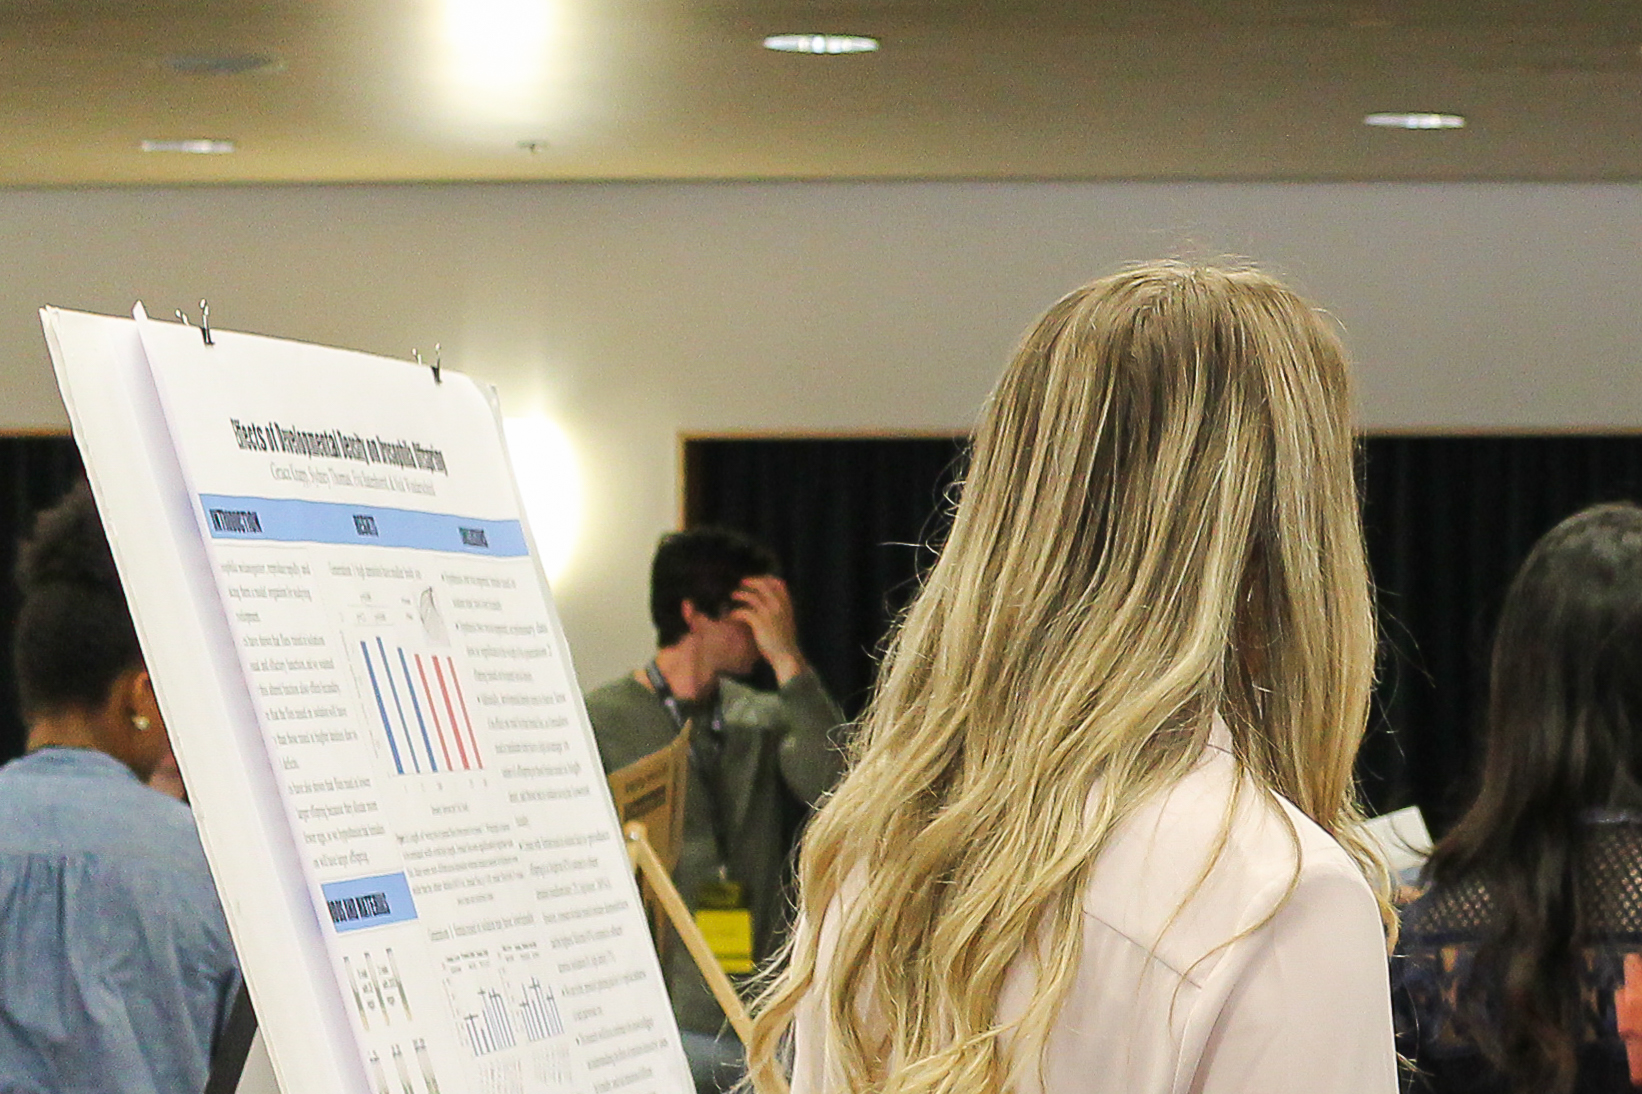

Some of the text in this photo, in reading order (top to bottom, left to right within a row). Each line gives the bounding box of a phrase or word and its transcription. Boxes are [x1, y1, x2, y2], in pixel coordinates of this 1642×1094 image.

[229, 417, 268, 452] Effects
[264, 421, 280, 453] of
[273, 422, 342, 459] Developmental
